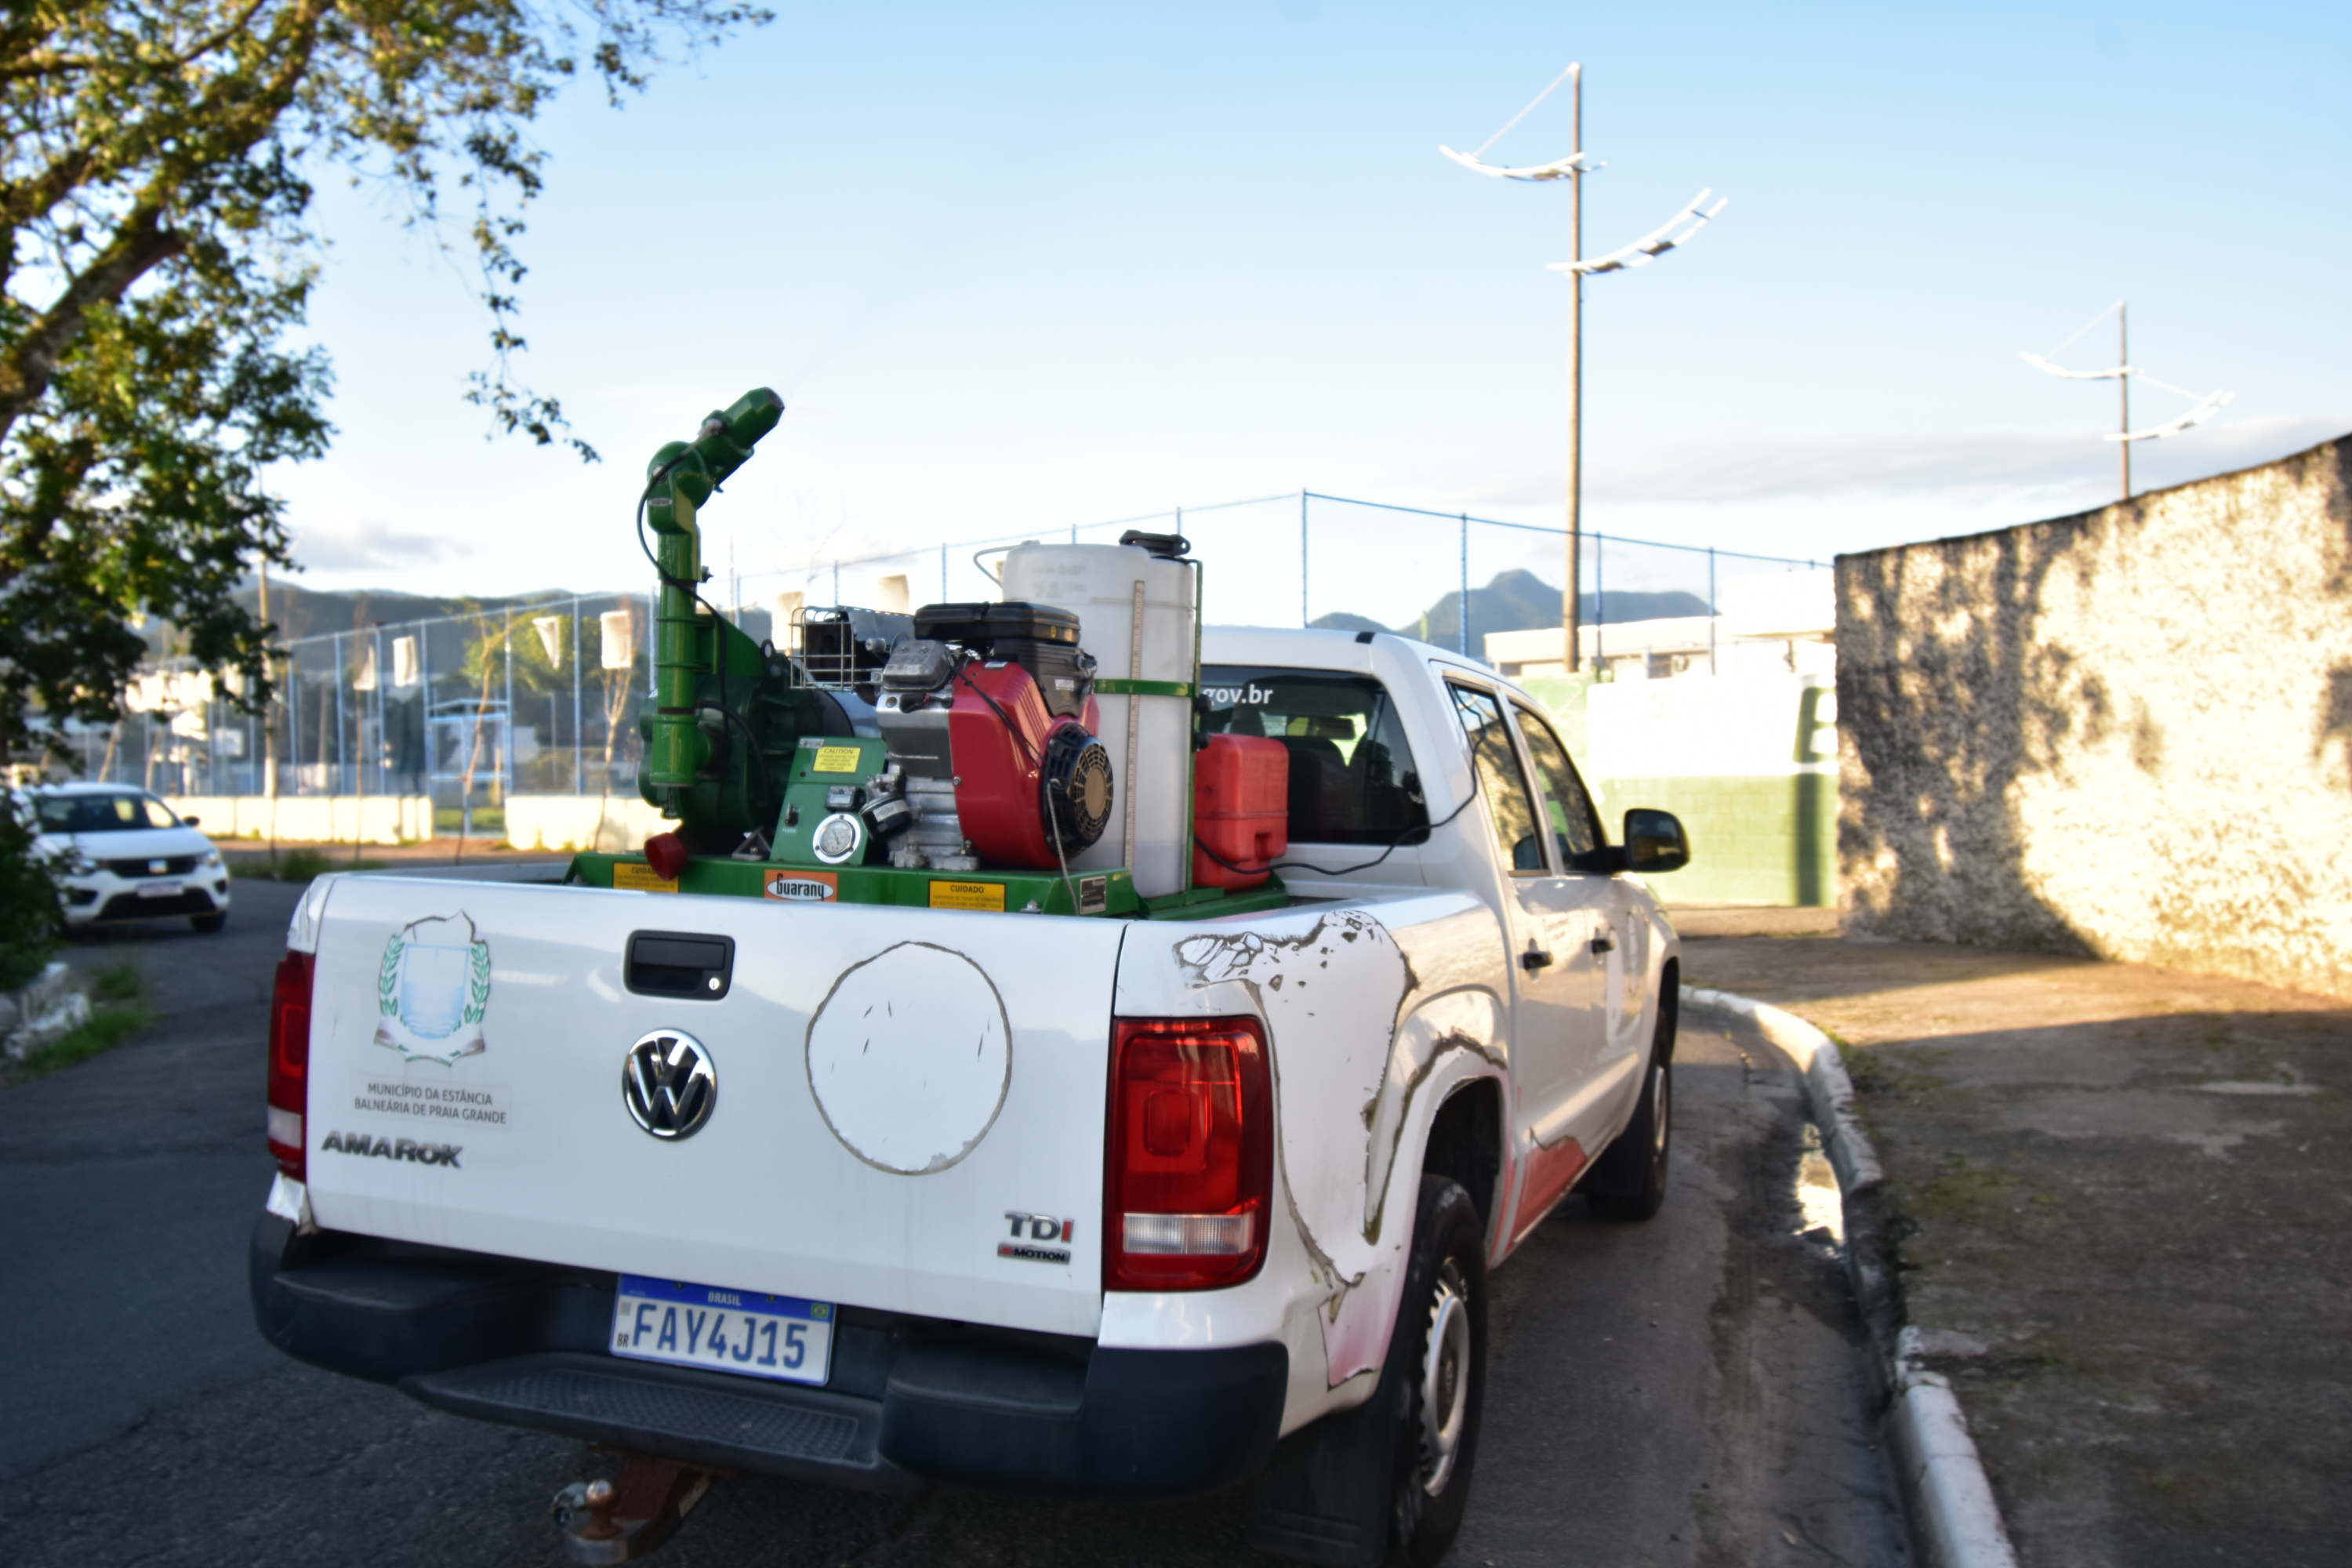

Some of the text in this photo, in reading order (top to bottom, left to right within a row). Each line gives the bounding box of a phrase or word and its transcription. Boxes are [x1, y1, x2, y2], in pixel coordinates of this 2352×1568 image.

[631, 866, 656, 875] CUIDA
[776, 873, 825, 901] Guarany
[950, 884, 985, 894] CUIDADO
[368, 1082, 492, 1106] MUNICÍPIO DA ESTÂNCIA
[354, 1097, 506, 1124] BALNEÁRIA DE PRAIA GRANDE
[321, 1131, 463, 1169] AMAROK
[1004, 1210, 1074, 1243] TDI
[707, 1290, 742, 1307] BRASIL
[616, 1332, 628, 1348] BR
[632, 1302, 808, 1370] FAY4J15
